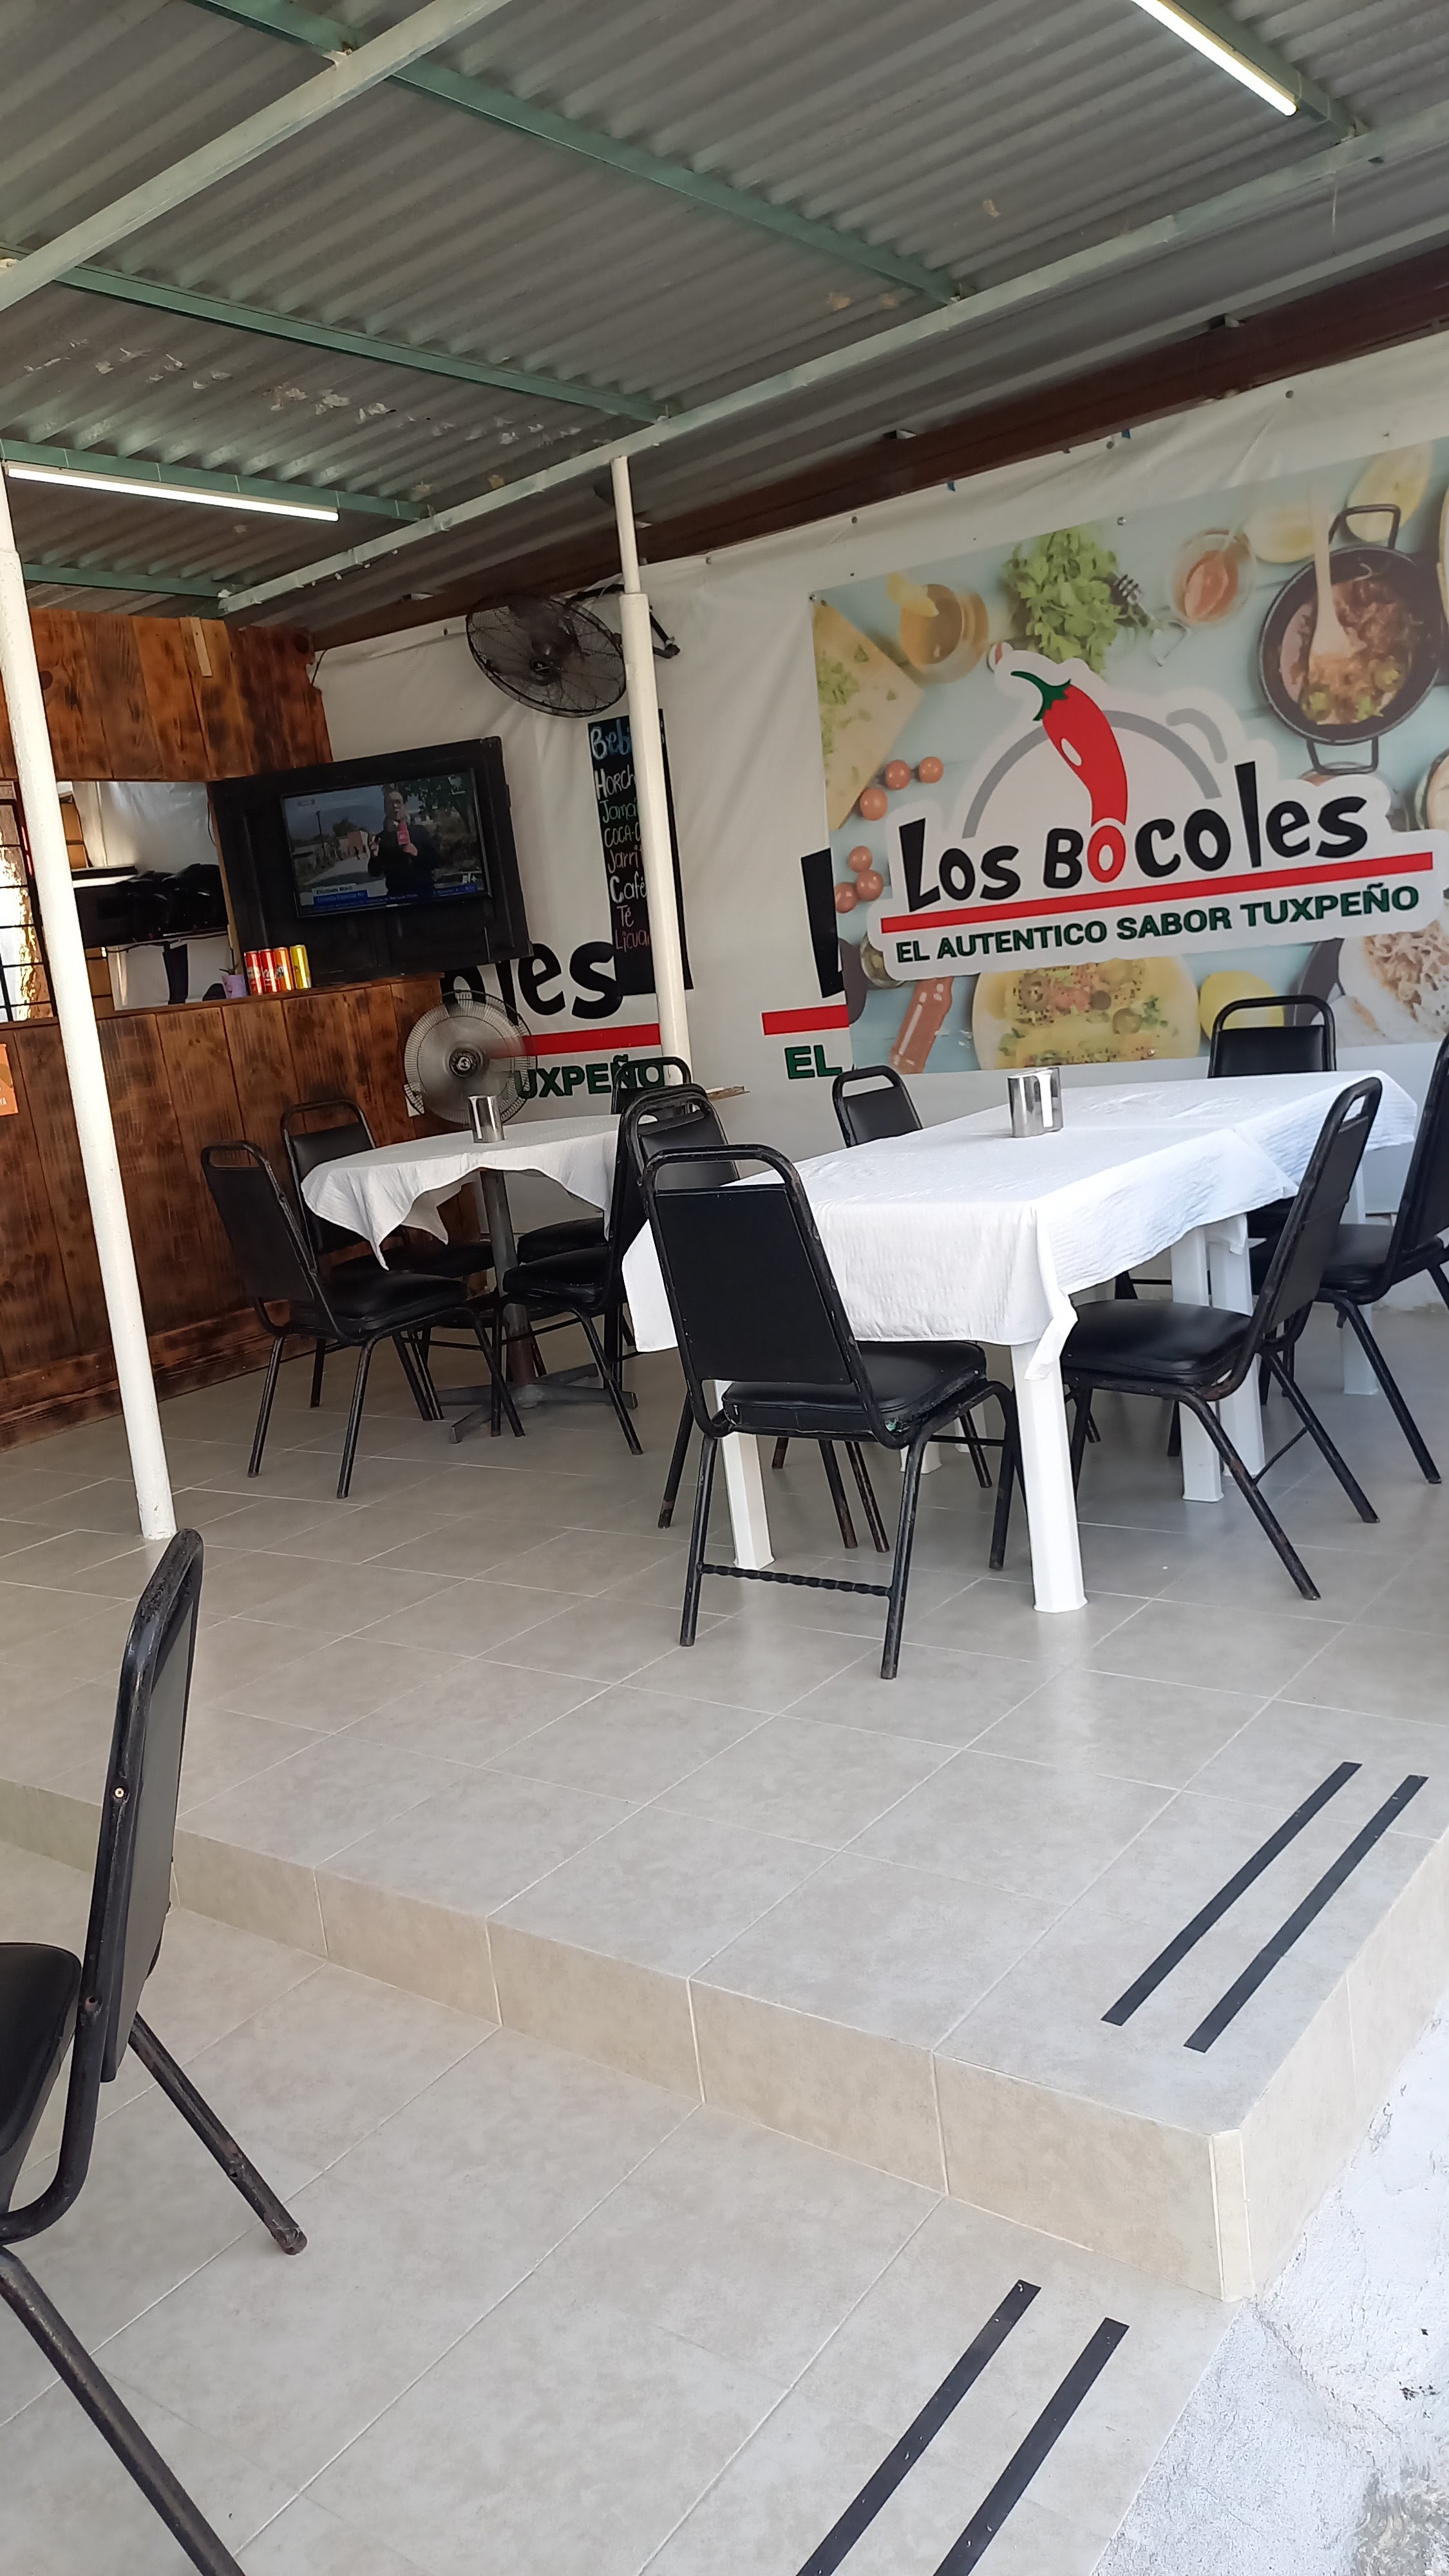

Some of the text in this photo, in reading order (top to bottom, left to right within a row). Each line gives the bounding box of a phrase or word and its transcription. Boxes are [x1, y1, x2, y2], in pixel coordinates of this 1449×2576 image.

[607, 844, 642, 874] Jarri
[898, 817, 1021, 913] Los
[609, 870, 647, 904] Café
[616, 904, 634, 927] Té
[896, 882, 1419, 963] EL AUTENTICO SABOR TUXPEÑO
[614, 929, 650, 953] Licua
[784, 1044, 843, 1080] EL
